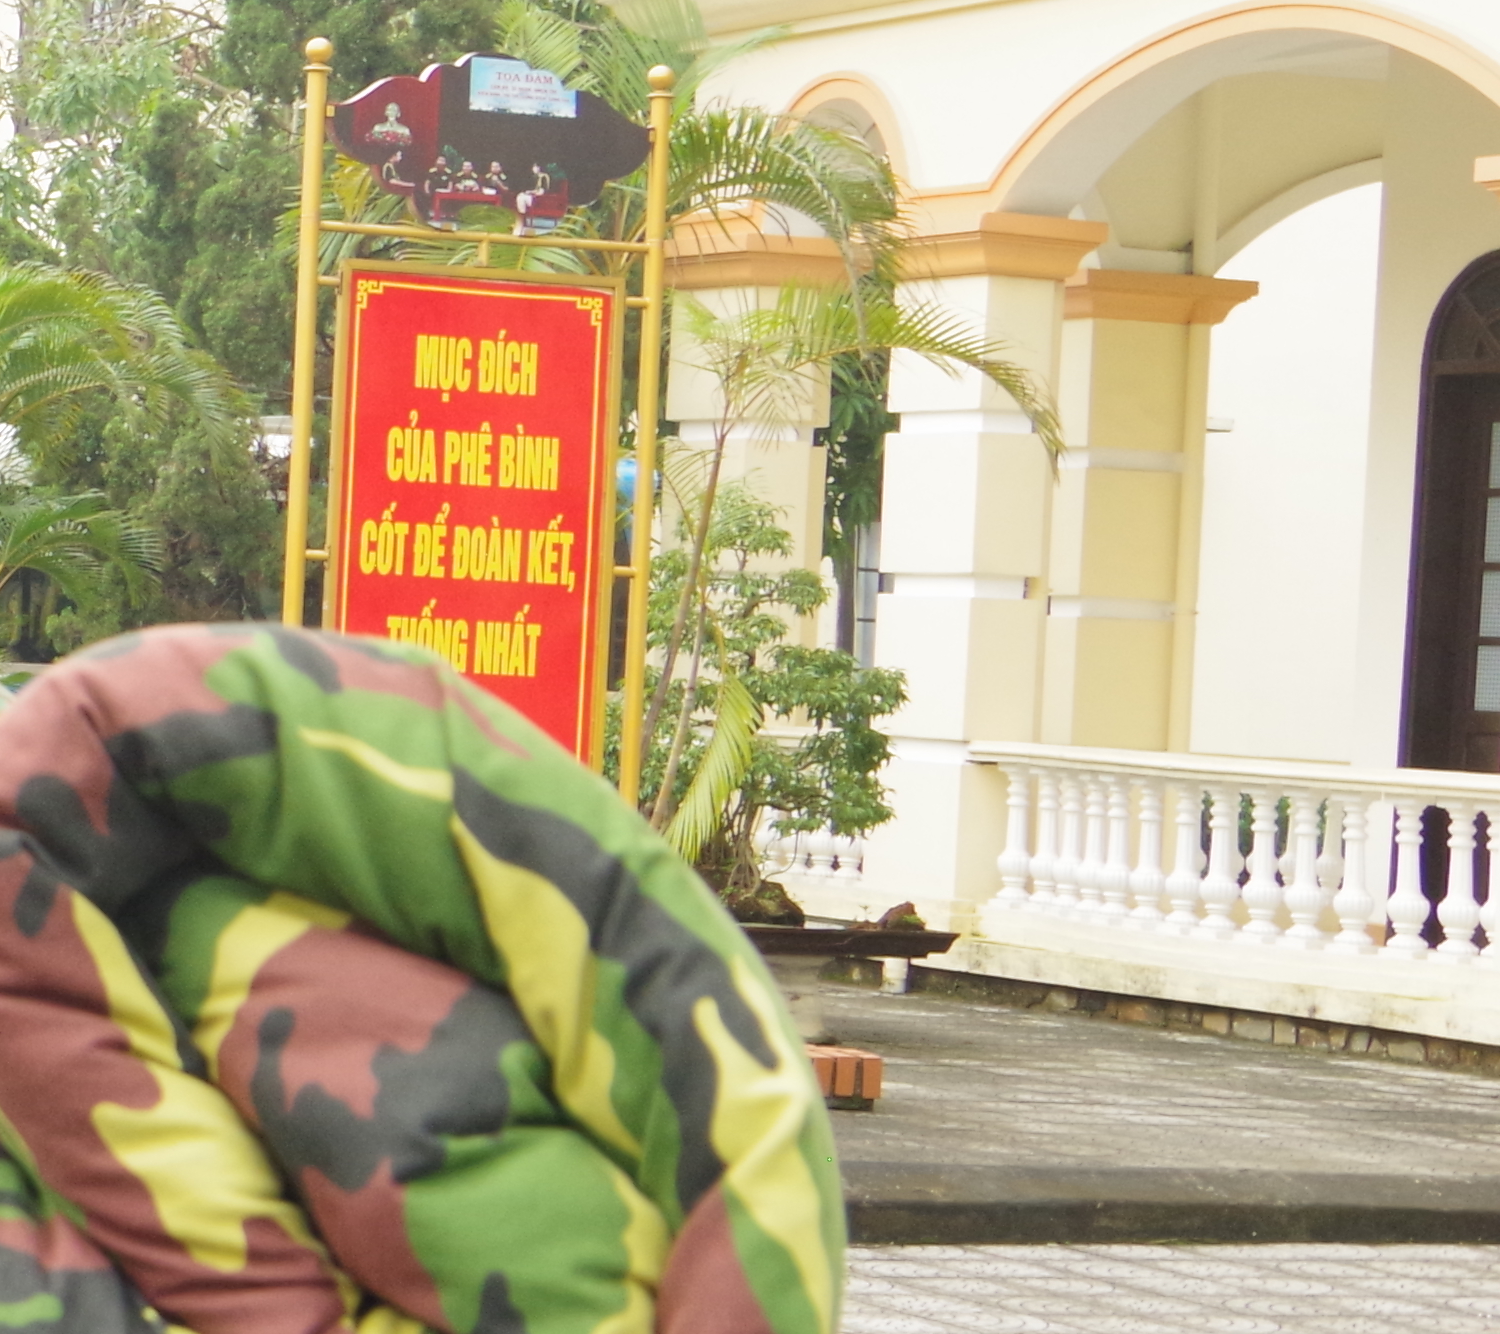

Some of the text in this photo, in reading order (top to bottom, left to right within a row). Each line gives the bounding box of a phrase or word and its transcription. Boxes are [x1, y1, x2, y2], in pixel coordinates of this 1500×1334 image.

[414, 329, 538, 403] MỤC ĐÍCH
[386, 409, 560, 491] CỦA PHÊ BÌNH
[359, 501, 575, 593] CỐT ĐỂ ĐOÀN KẾT,
[473, 603, 542, 678] NHẤT
